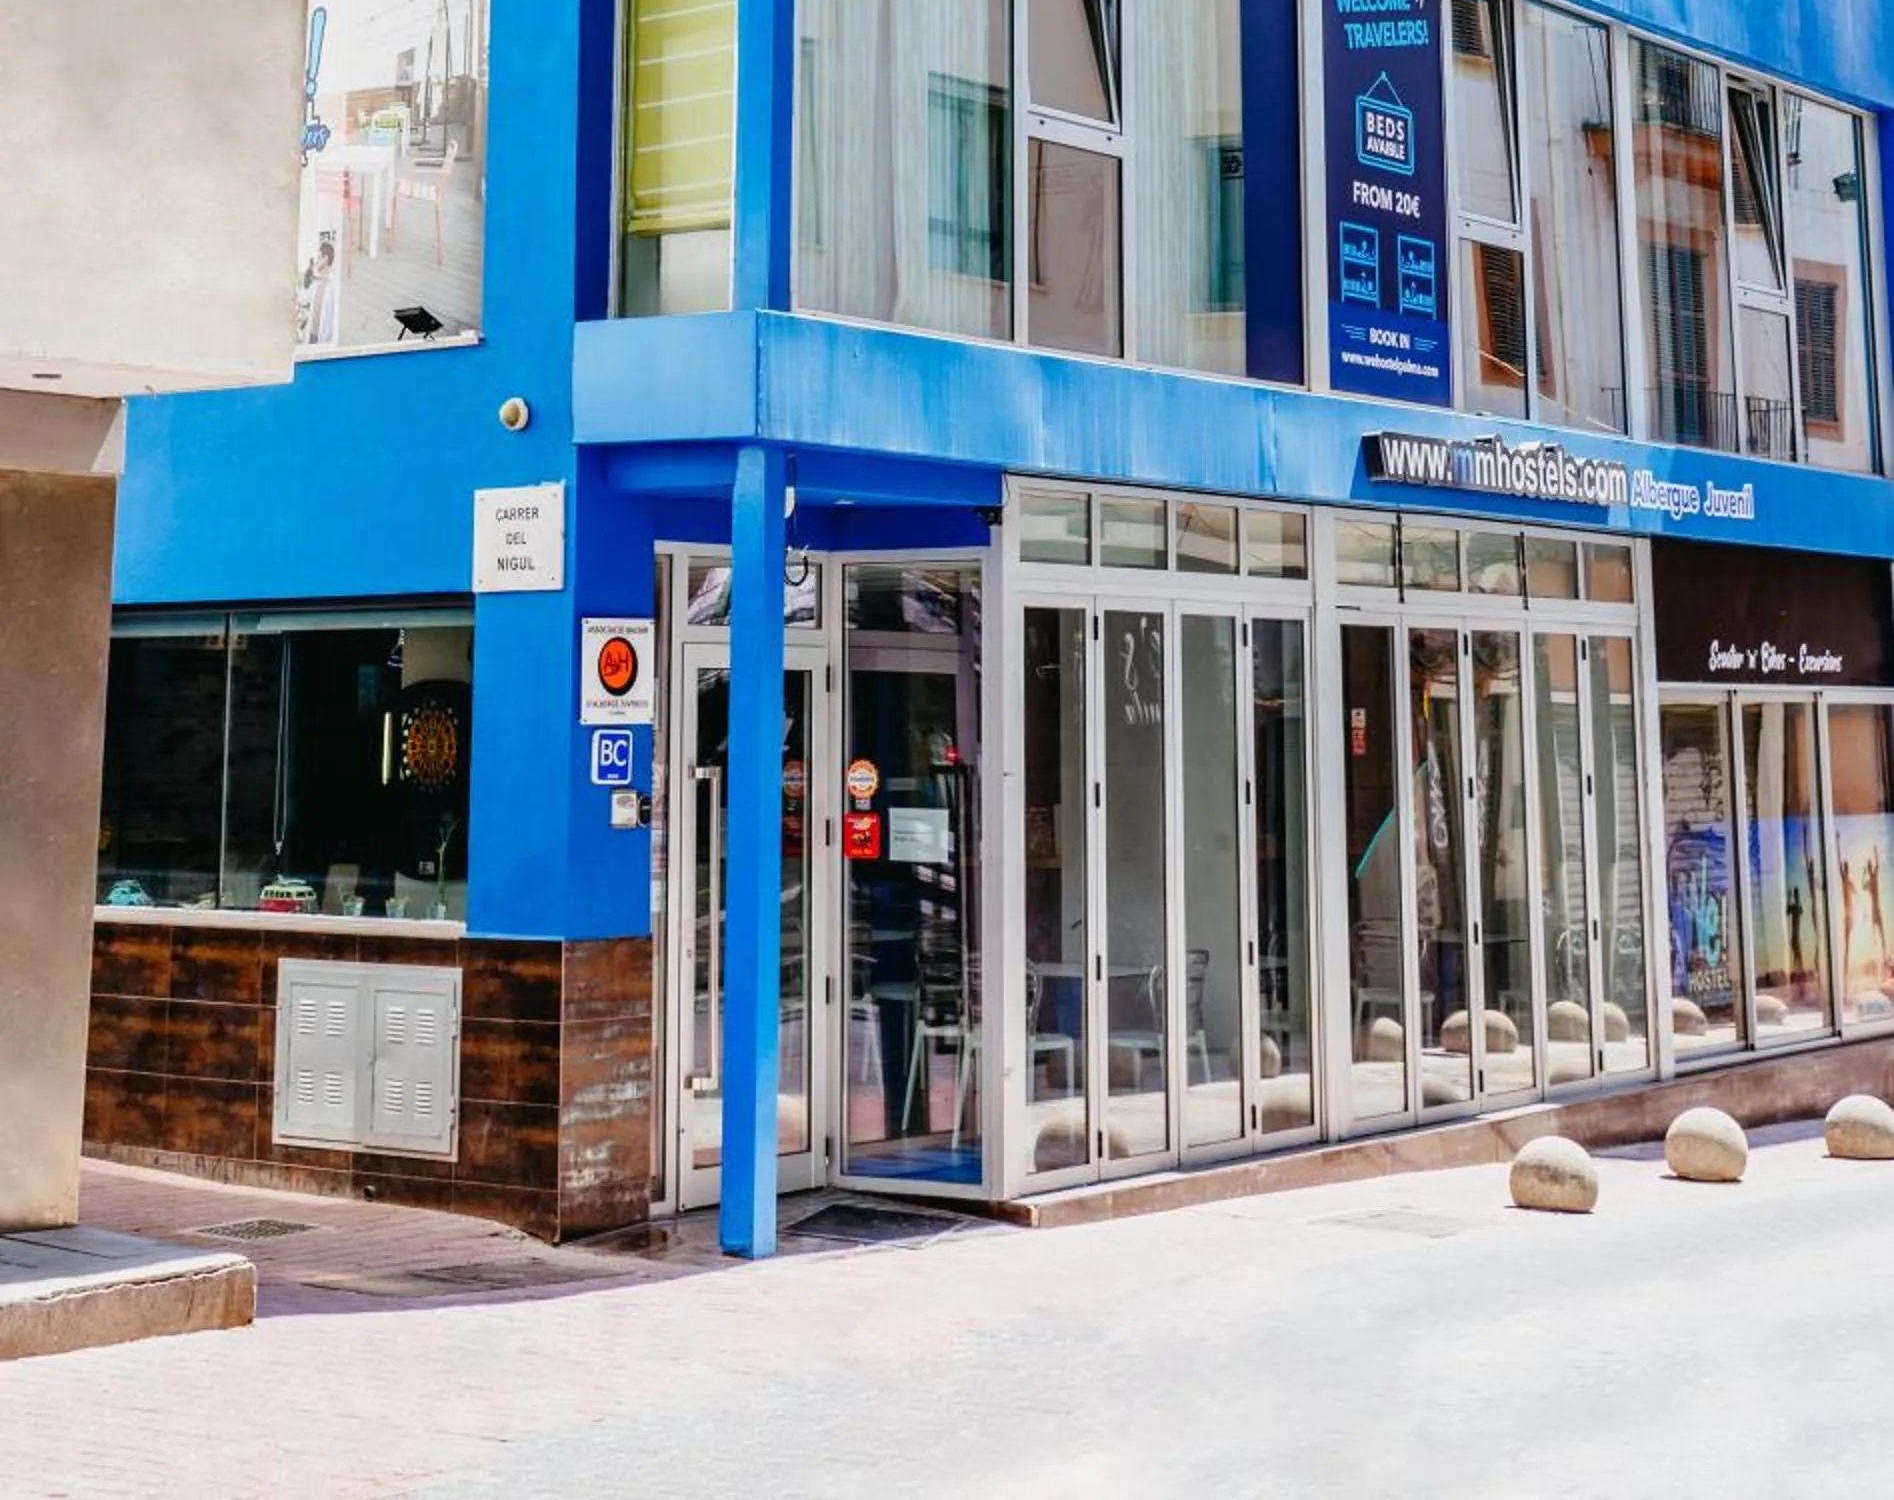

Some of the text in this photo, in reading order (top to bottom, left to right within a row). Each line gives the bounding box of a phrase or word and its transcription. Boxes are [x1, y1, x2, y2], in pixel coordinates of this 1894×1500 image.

[1344, 20, 1429, 49] TRAVELERS!
[1366, 112, 1405, 141] BEDS
[1353, 180, 1421, 218] FROM 20€
[1369, 326, 1411, 350] BOOK IN
[1384, 438, 1628, 502] www.mmhostels.com
[1630, 470, 1755, 520] Albergue Juvenil
[496, 506, 539, 521] CARRER
[506, 531, 527, 545] DEL
[497, 557, 536, 571] NIGUL
[601, 739, 628, 767] BC
[1688, 967, 1731, 994] HOSTEL
